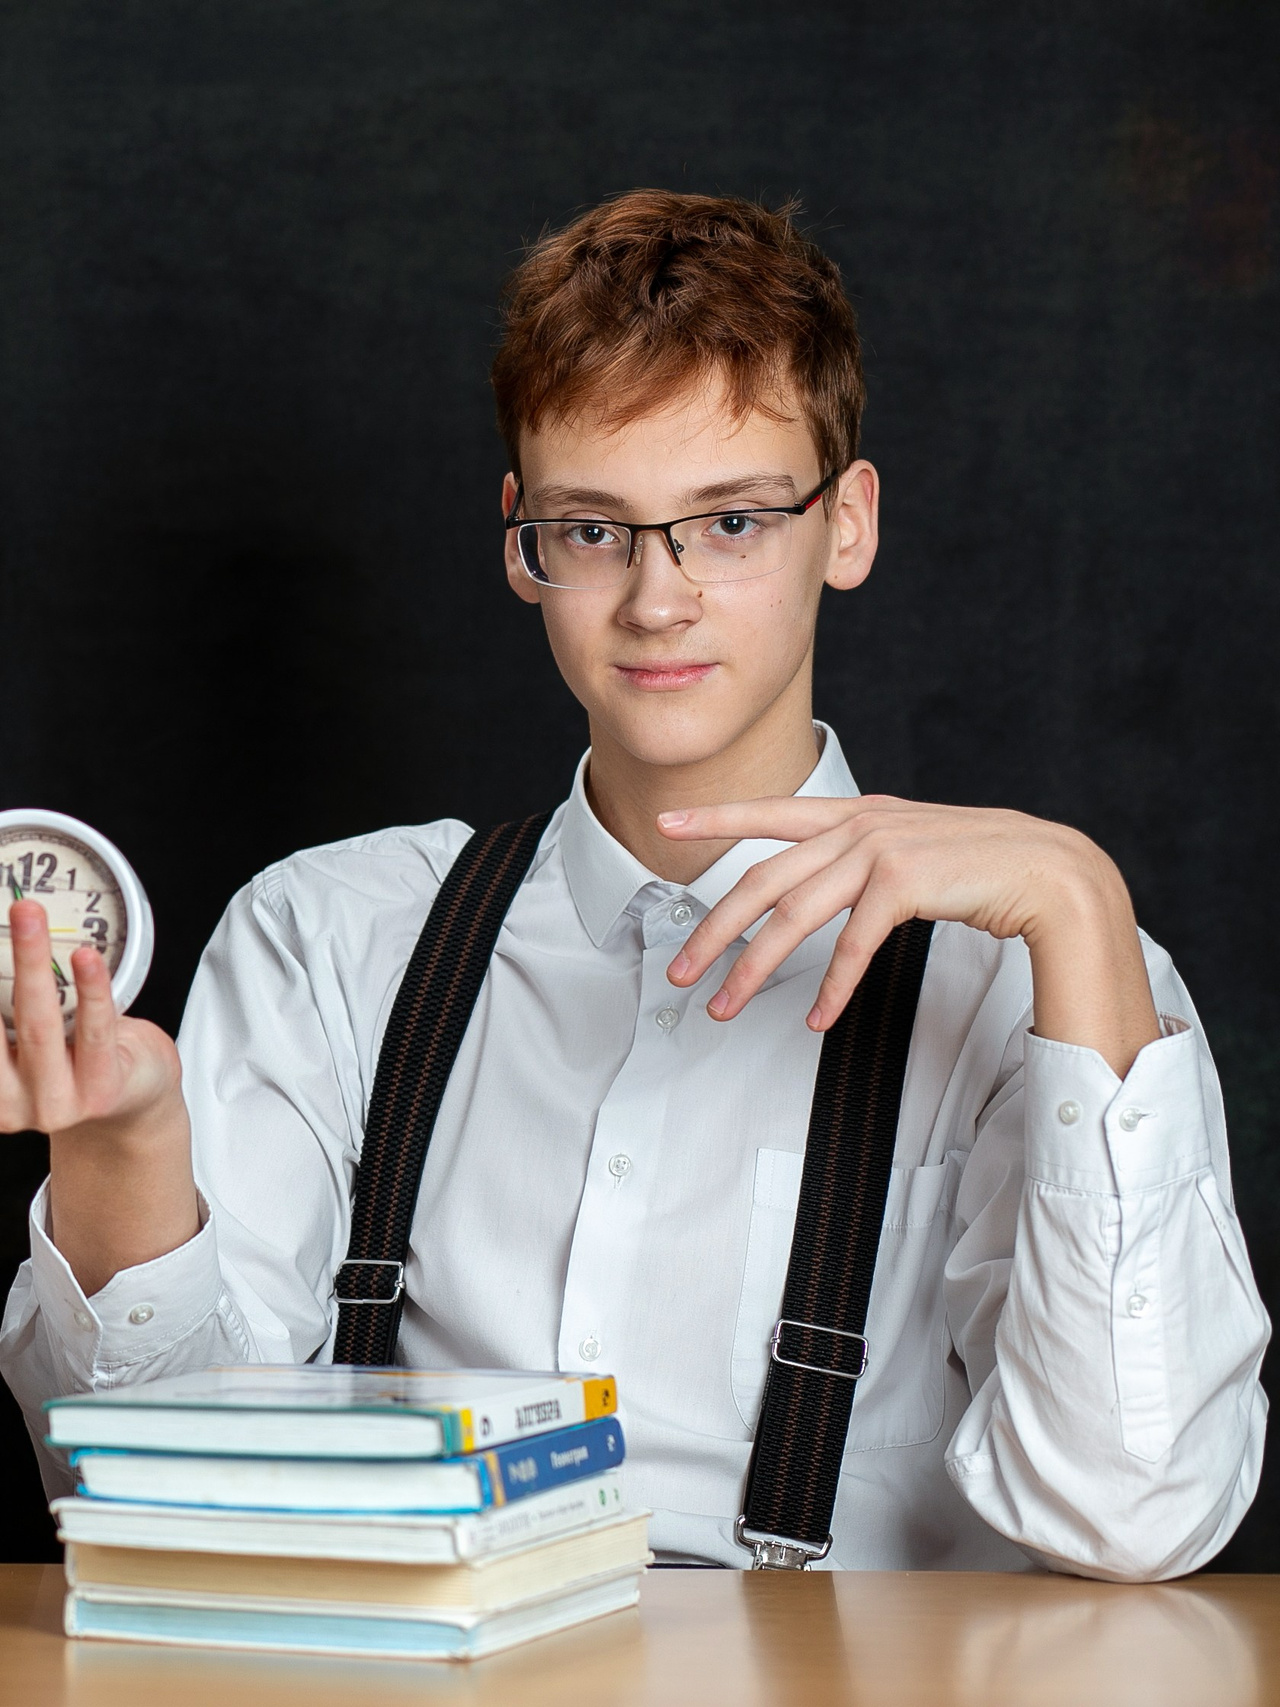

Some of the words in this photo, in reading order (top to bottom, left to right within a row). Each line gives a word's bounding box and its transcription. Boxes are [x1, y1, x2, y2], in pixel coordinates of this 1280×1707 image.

[18, 852, 58, 893] 12
[67, 868, 76, 890] 1
[86, 893, 101, 913] 2
[83, 917, 108, 954] 3
